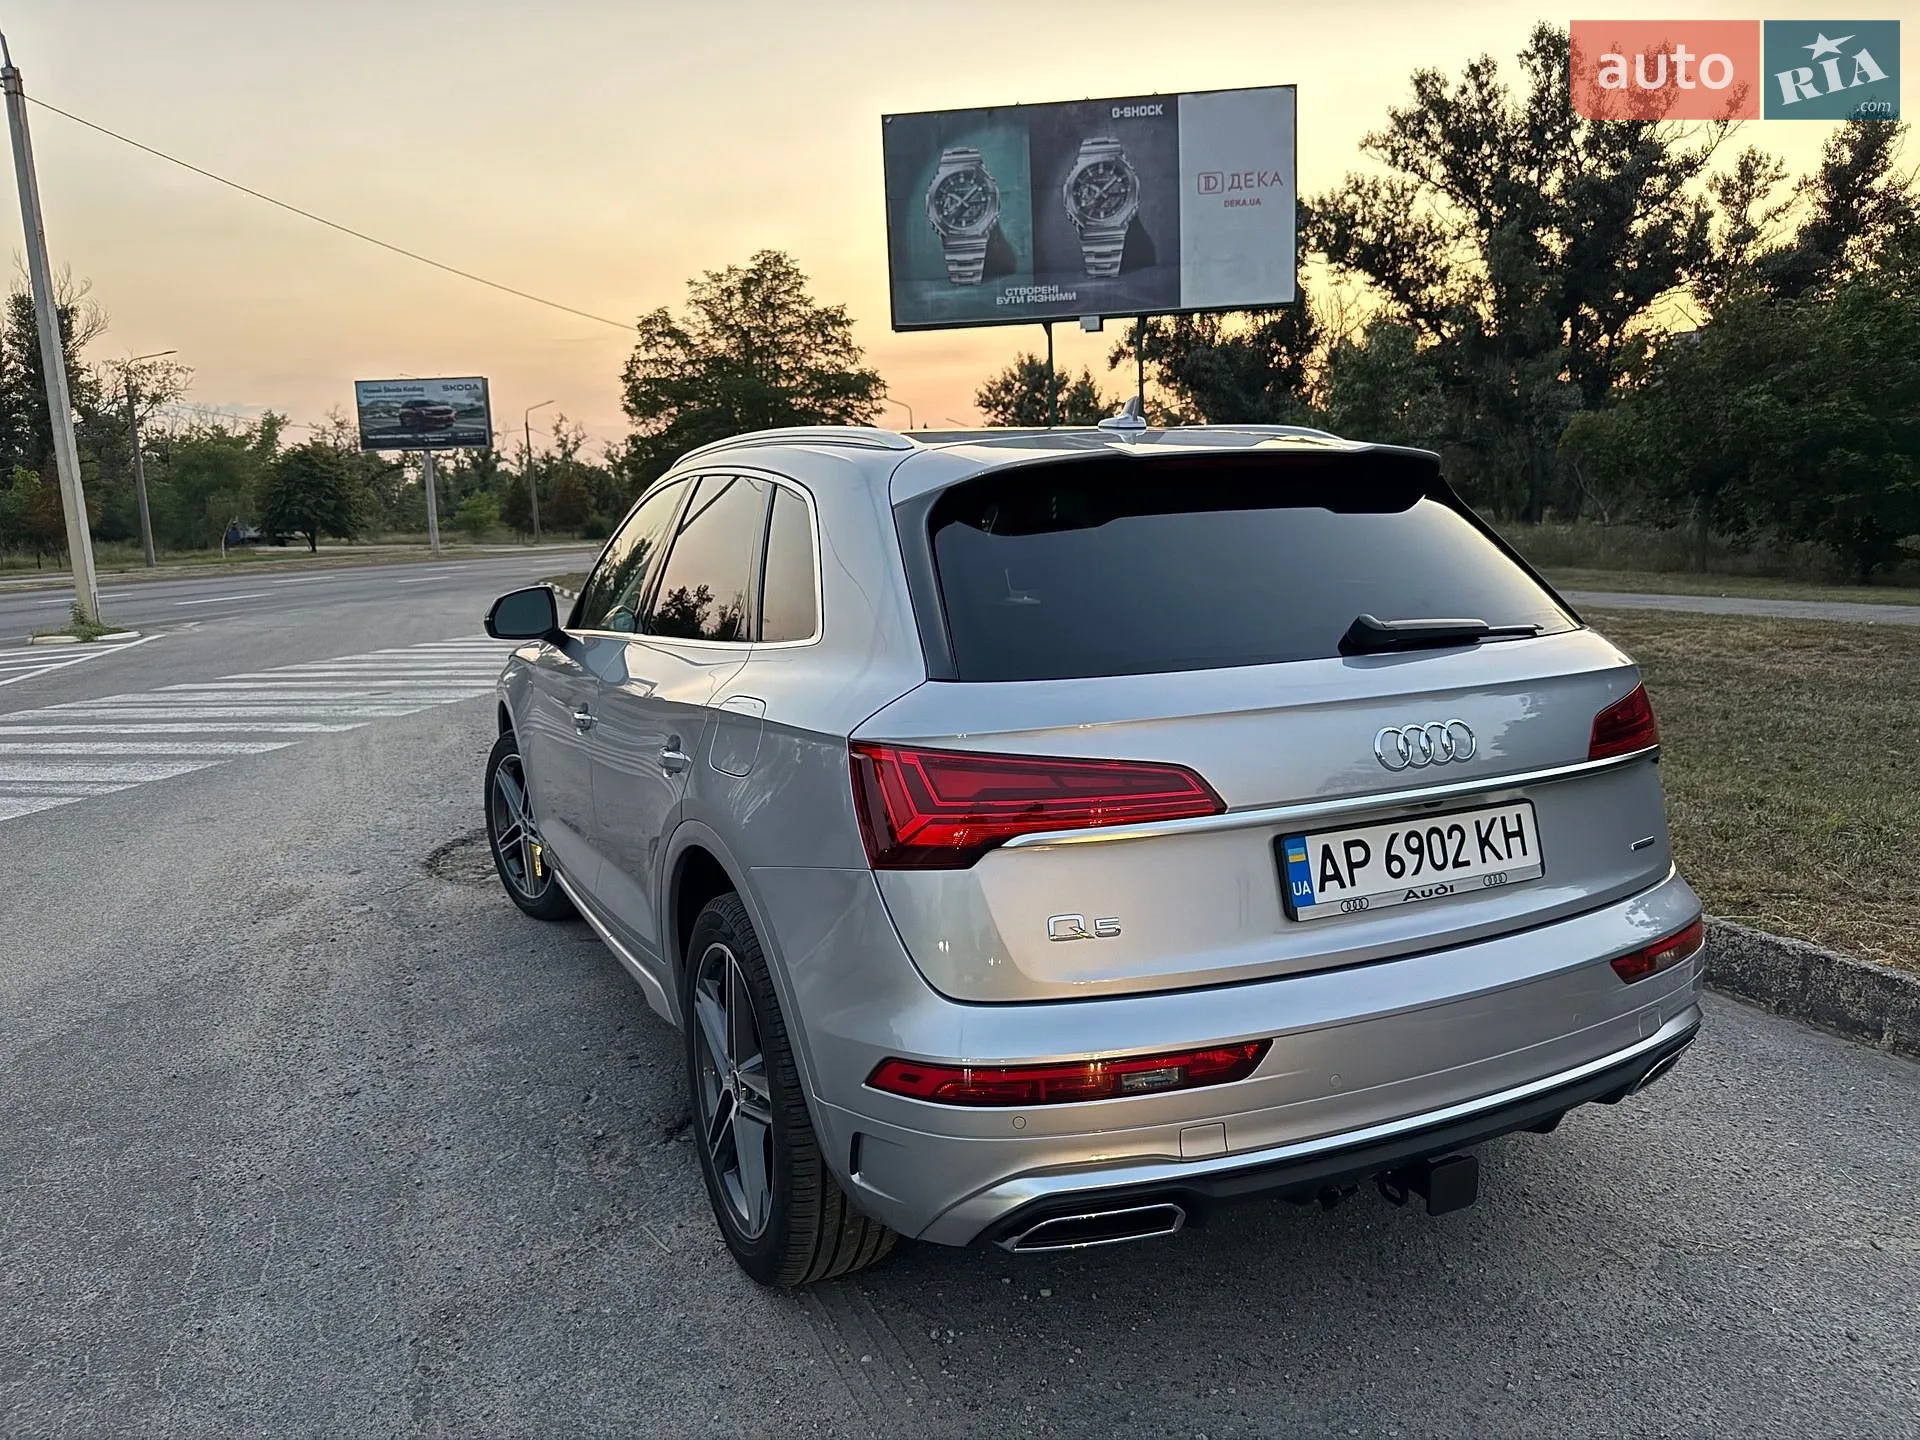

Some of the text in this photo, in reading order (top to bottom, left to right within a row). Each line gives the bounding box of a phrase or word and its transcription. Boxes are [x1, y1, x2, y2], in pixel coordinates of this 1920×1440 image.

[1111, 104, 1164, 118] G-SHOCK
[1228, 171, 1284, 192] ДЕКА
[996, 291, 1077, 305] БУТИ РІЗНИМИ
[1005, 284, 1059, 297] СТВОРЕНІ
[1318, 813, 1528, 893] AP 6902 KH
[1292, 881, 1312, 896] UA
[1402, 883, 1456, 902] Audi
[1047, 913, 1122, 942] Q5
